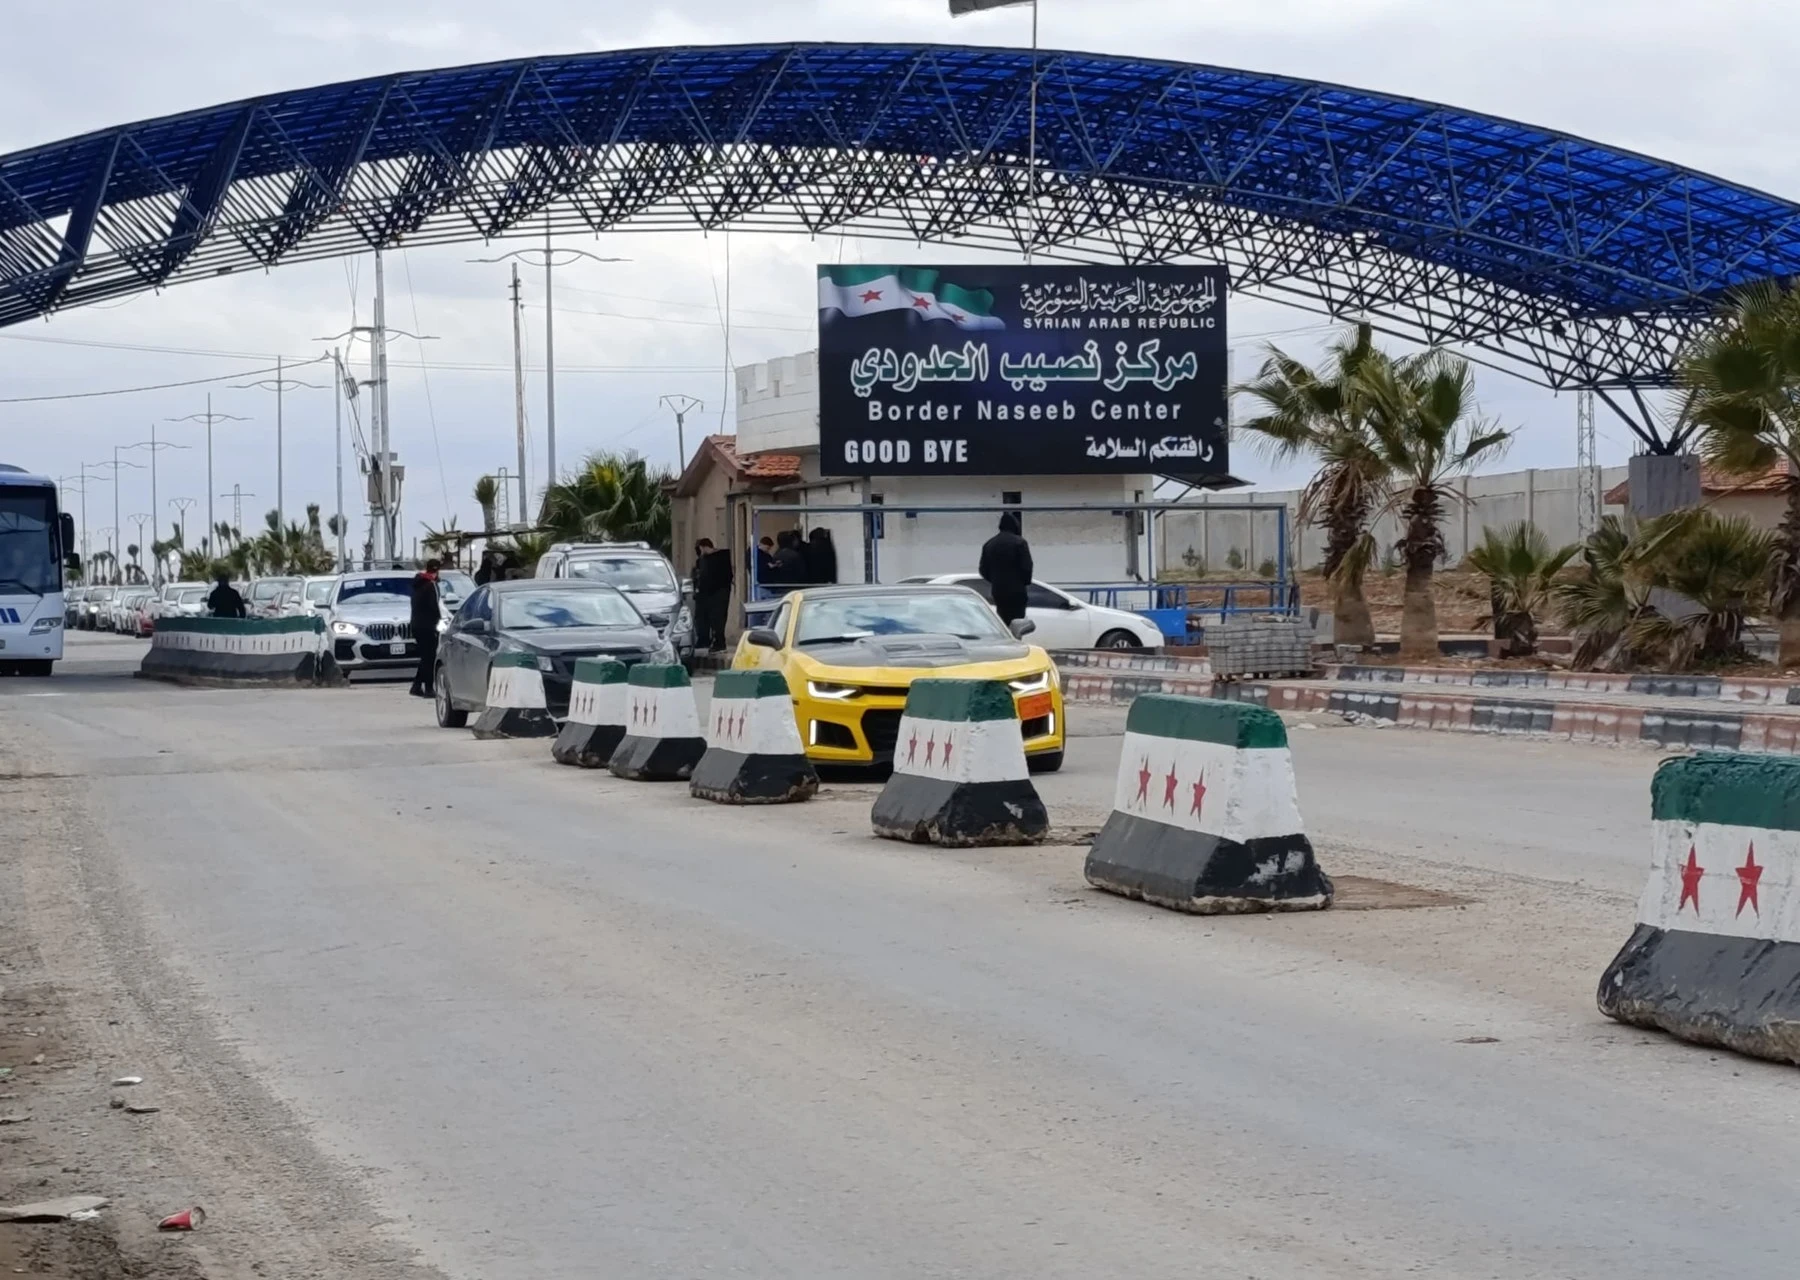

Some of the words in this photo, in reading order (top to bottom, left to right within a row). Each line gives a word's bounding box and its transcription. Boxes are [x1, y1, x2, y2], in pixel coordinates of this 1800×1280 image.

[1023, 317, 1081, 329] SYRIAN
[1088, 317, 1130, 329] ARAB
[1137, 317, 1215, 329] REPUBLIC
[850, 340, 989, 397] الحدودي
[1000, 339, 1102, 392] نصيب
[1103, 339, 1197, 392] مركز
[868, 400, 962, 421] Border
[977, 400, 1076, 421] Naseeb
[1090, 399, 1181, 420] Center
[844, 440, 911, 463] GOOD
[923, 440, 968, 463] BYE
[1085, 437, 1147, 460] السلامة
[1149, 435, 1214, 463] رافقتكم
